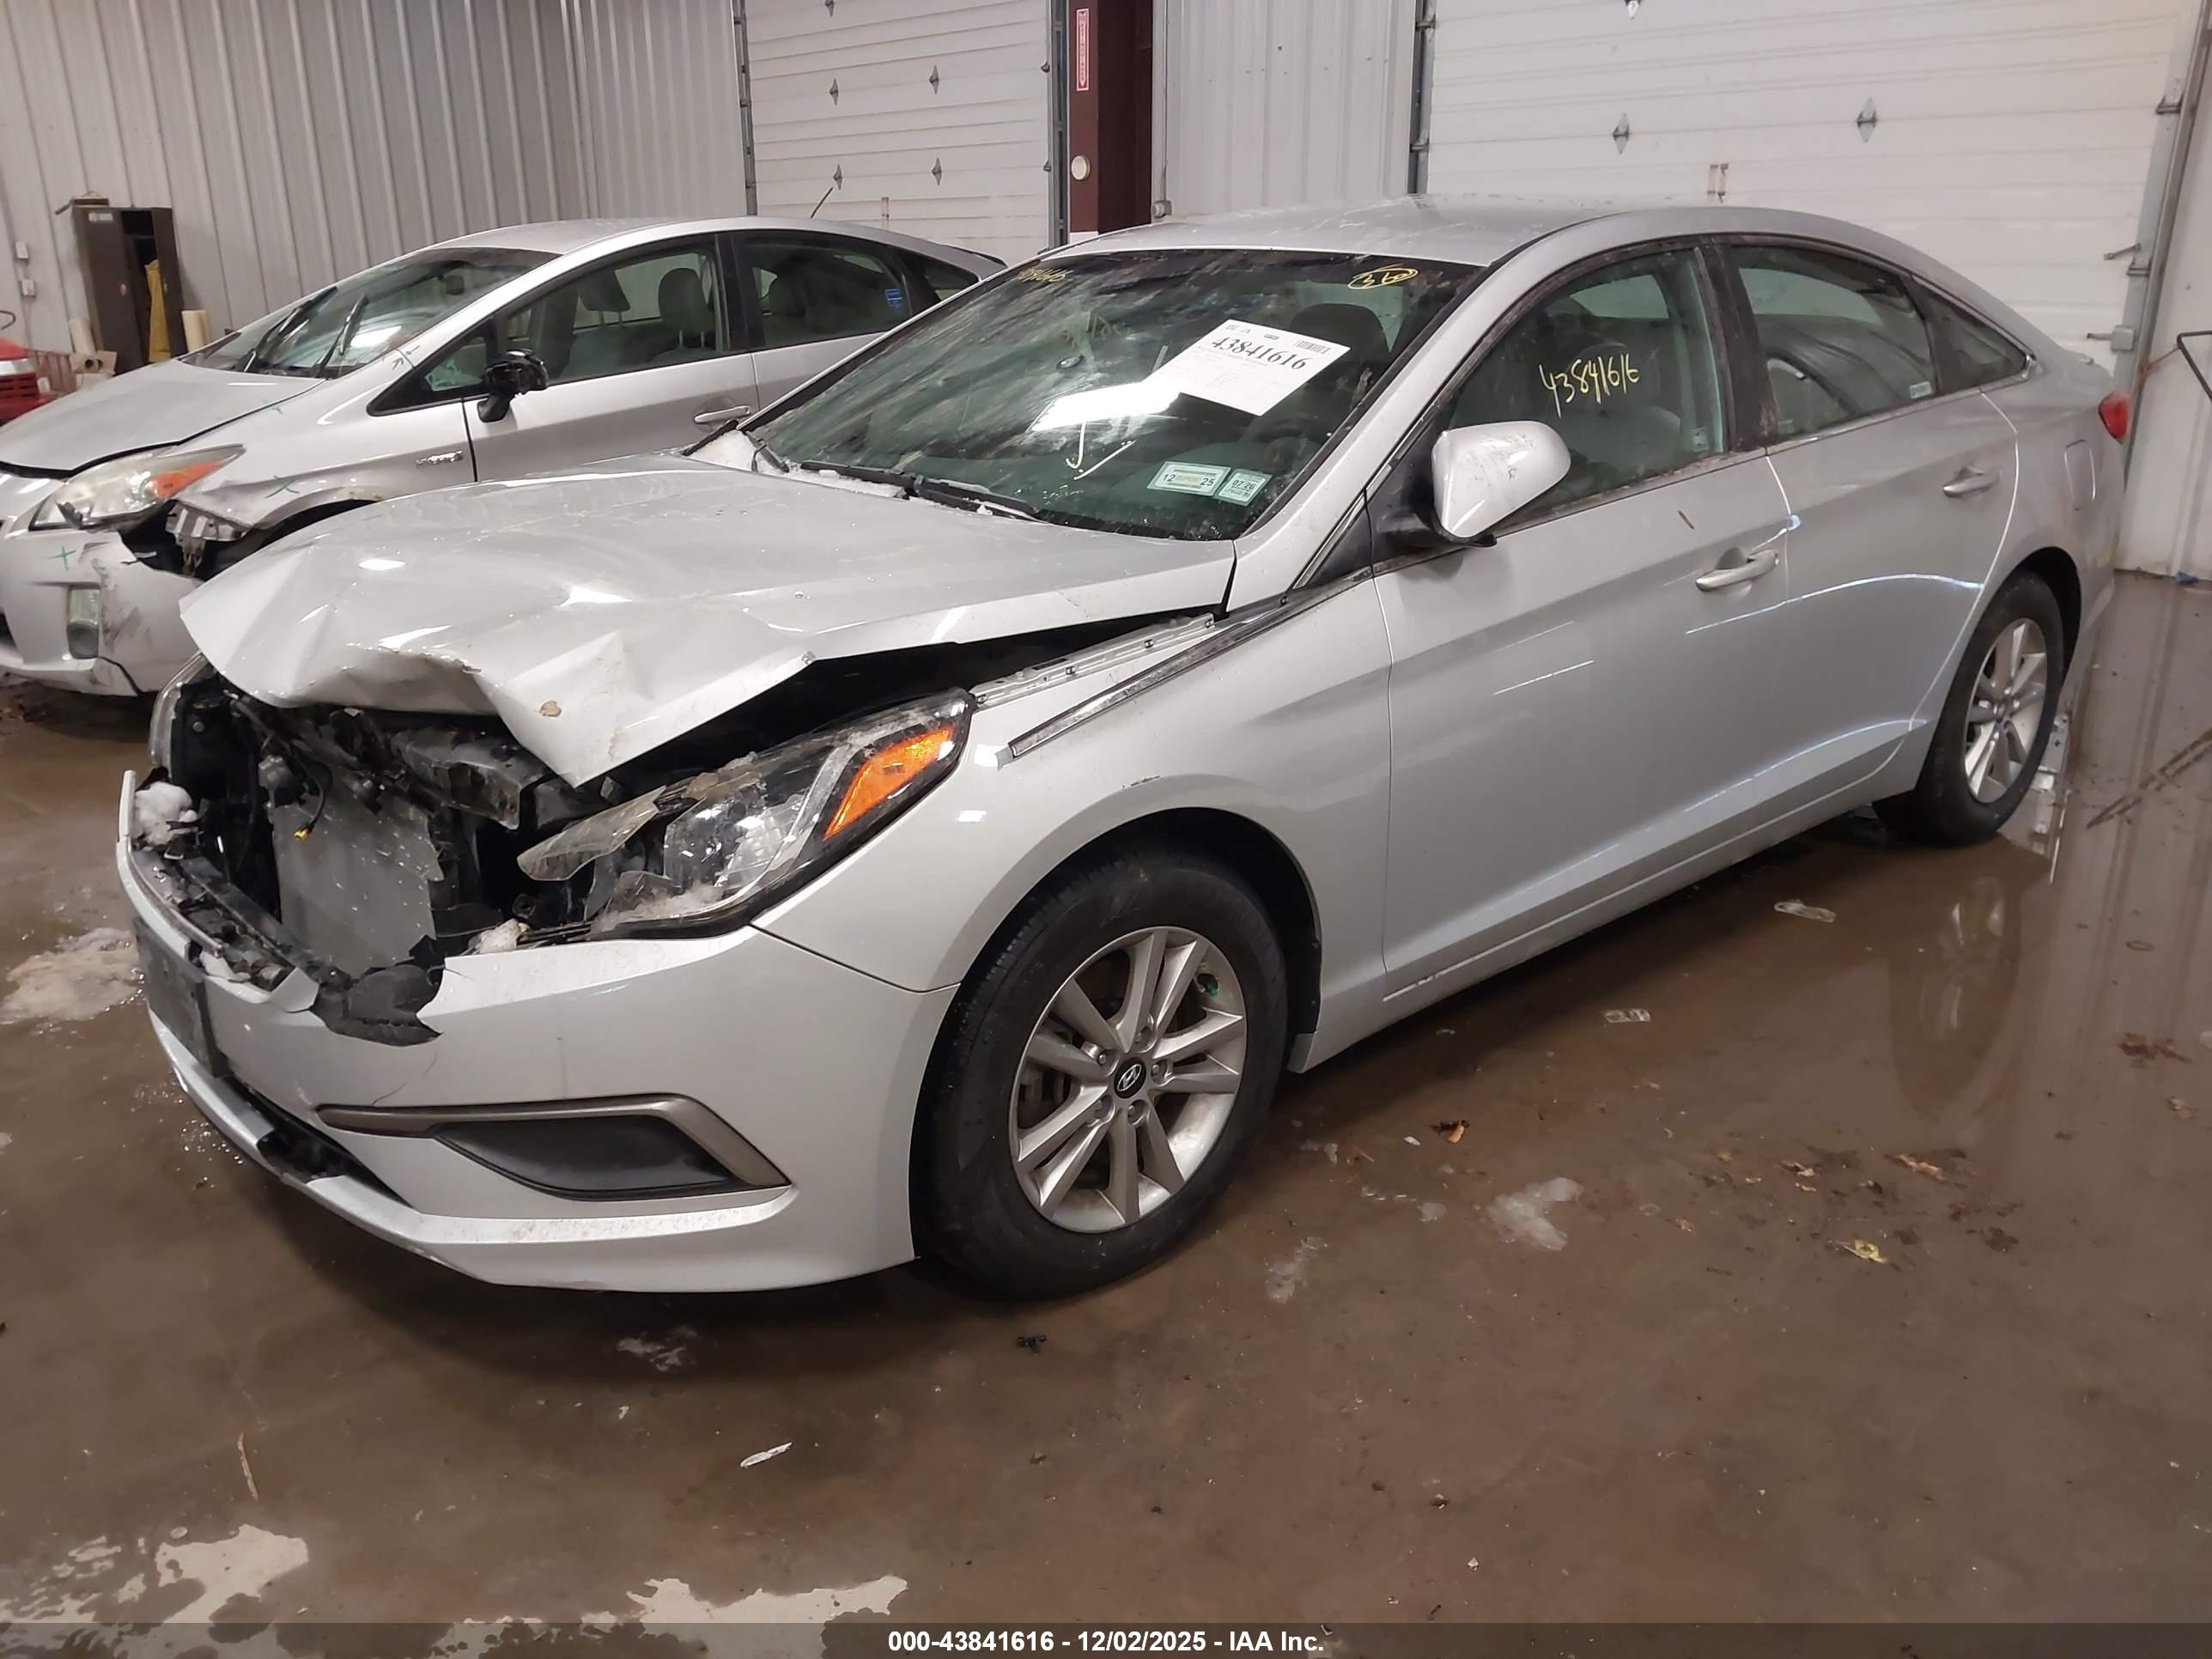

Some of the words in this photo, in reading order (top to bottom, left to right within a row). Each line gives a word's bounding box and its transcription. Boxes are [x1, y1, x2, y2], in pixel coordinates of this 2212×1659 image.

[1211, 336, 1313, 370] 43841616
[1538, 353, 1640, 419] 43841616
[1163, 473, 1176, 482] 12
[1200, 477, 1215, 487] 25
